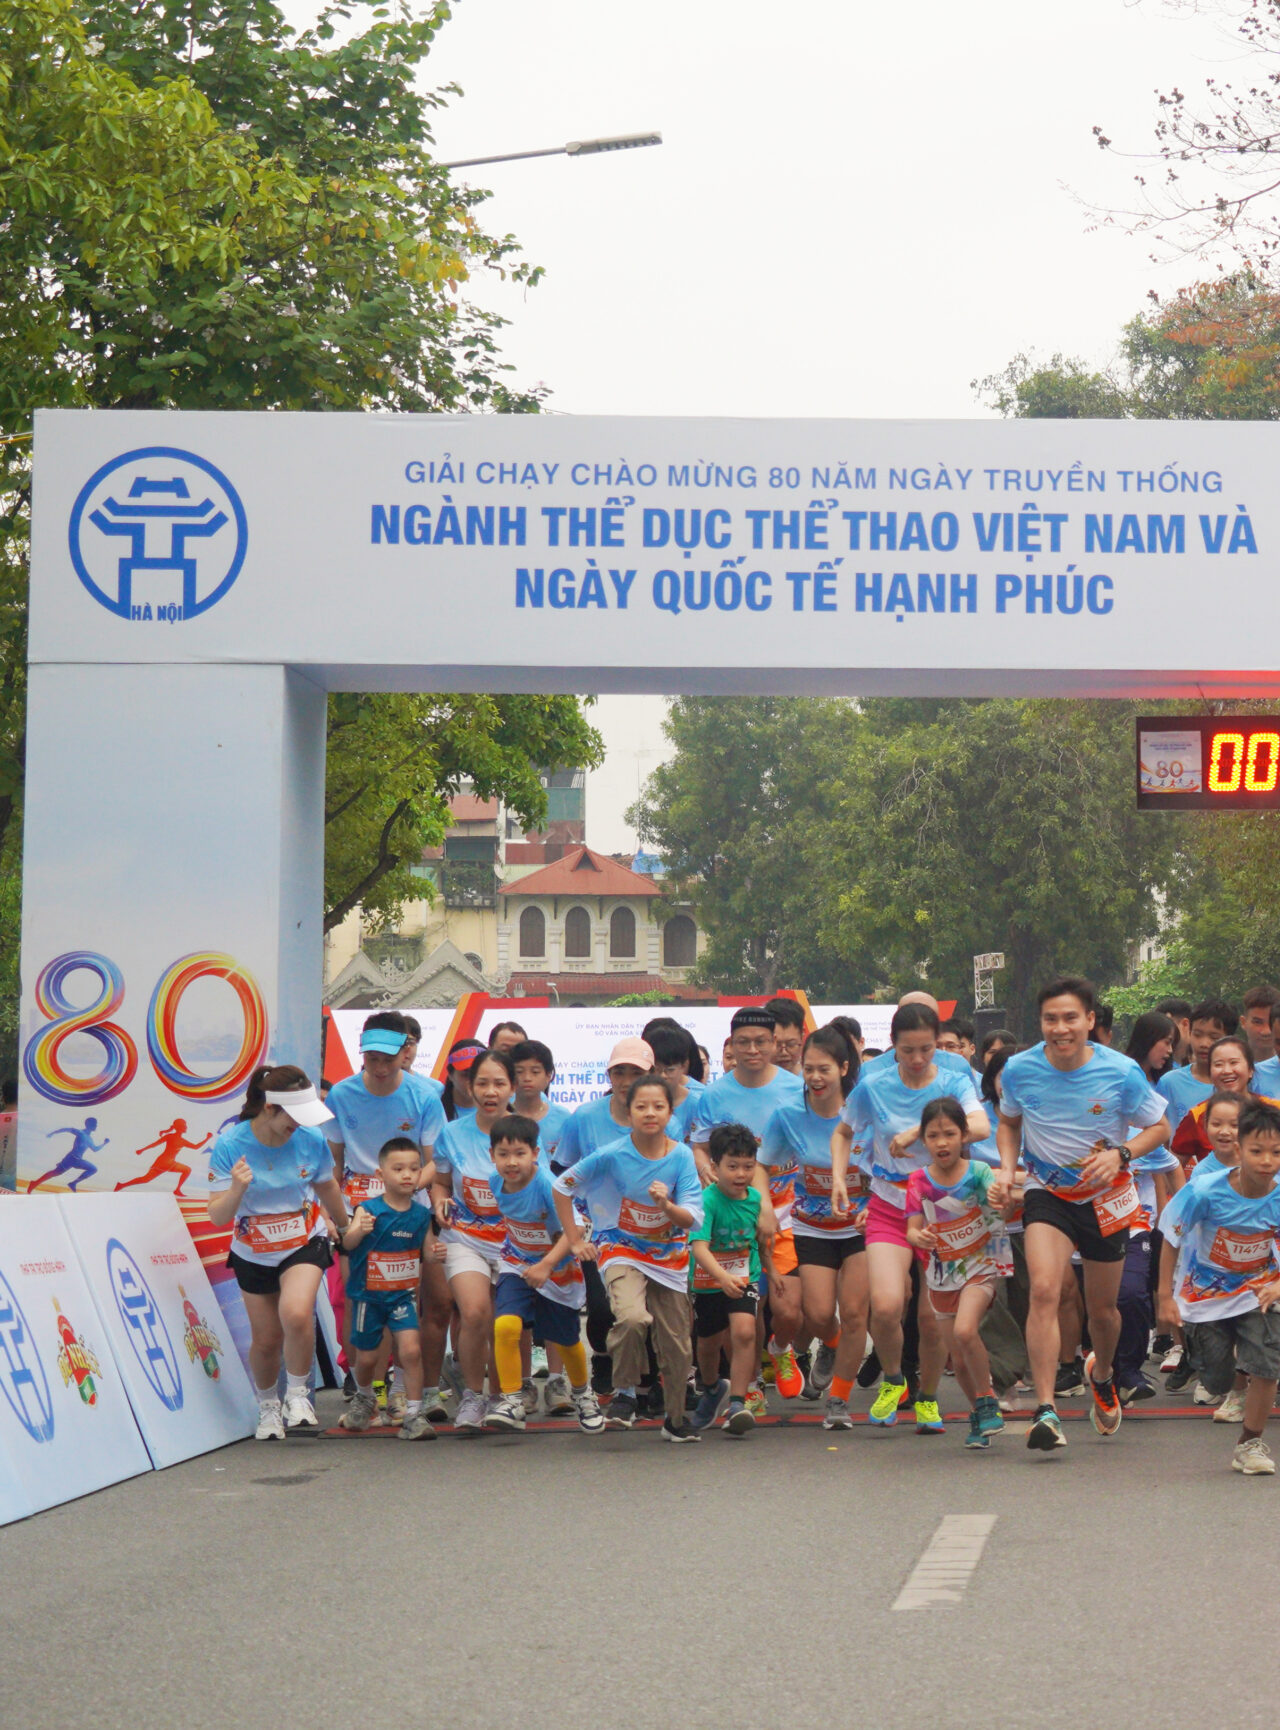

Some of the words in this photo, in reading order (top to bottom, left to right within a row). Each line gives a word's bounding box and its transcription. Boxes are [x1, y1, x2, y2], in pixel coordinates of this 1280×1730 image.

[405, 453, 465, 484] GIẢI
[476, 462, 560, 489] CHẠY
[571, 458, 657, 487] CHÀO
[668, 461, 757, 489] MỪNG
[768, 467, 801, 489] 80
[813, 461, 877, 489] NĂM
[889, 462, 973, 490] NGÀY
[984, 460, 1105, 492] TRUYỀN
[1117, 461, 1222, 493] THỐNG
[371, 494, 527, 547] NGÀNH
[541, 495, 636, 548] THỂ
[643, 508, 731, 559] DỤC
[745, 498, 839, 551] THỂ
[842, 511, 960, 552] THAO
[973, 502, 1069, 563] VIỆT
[1084, 513, 1186, 554] NAM
[1199, 503, 1259, 555] VÀ
[515, 558, 638, 610] NGÀY
[652, 555, 773, 616] QUỐC
[785, 557, 844, 612] TẾ
[855, 572, 978, 623] HẠNH
[995, 564, 1115, 615] PHÚC
[131, 602, 152, 621] HÀ
[157, 602, 182, 624] NỘI
[23, 950, 269, 1107] 80
[266, 1219, 300, 1235] 1117-2
[946, 1219, 984, 1243] 1160-3
[1232, 1241, 1269, 1254] 1147-3
[386, 1261, 416, 1272] 1117-3
